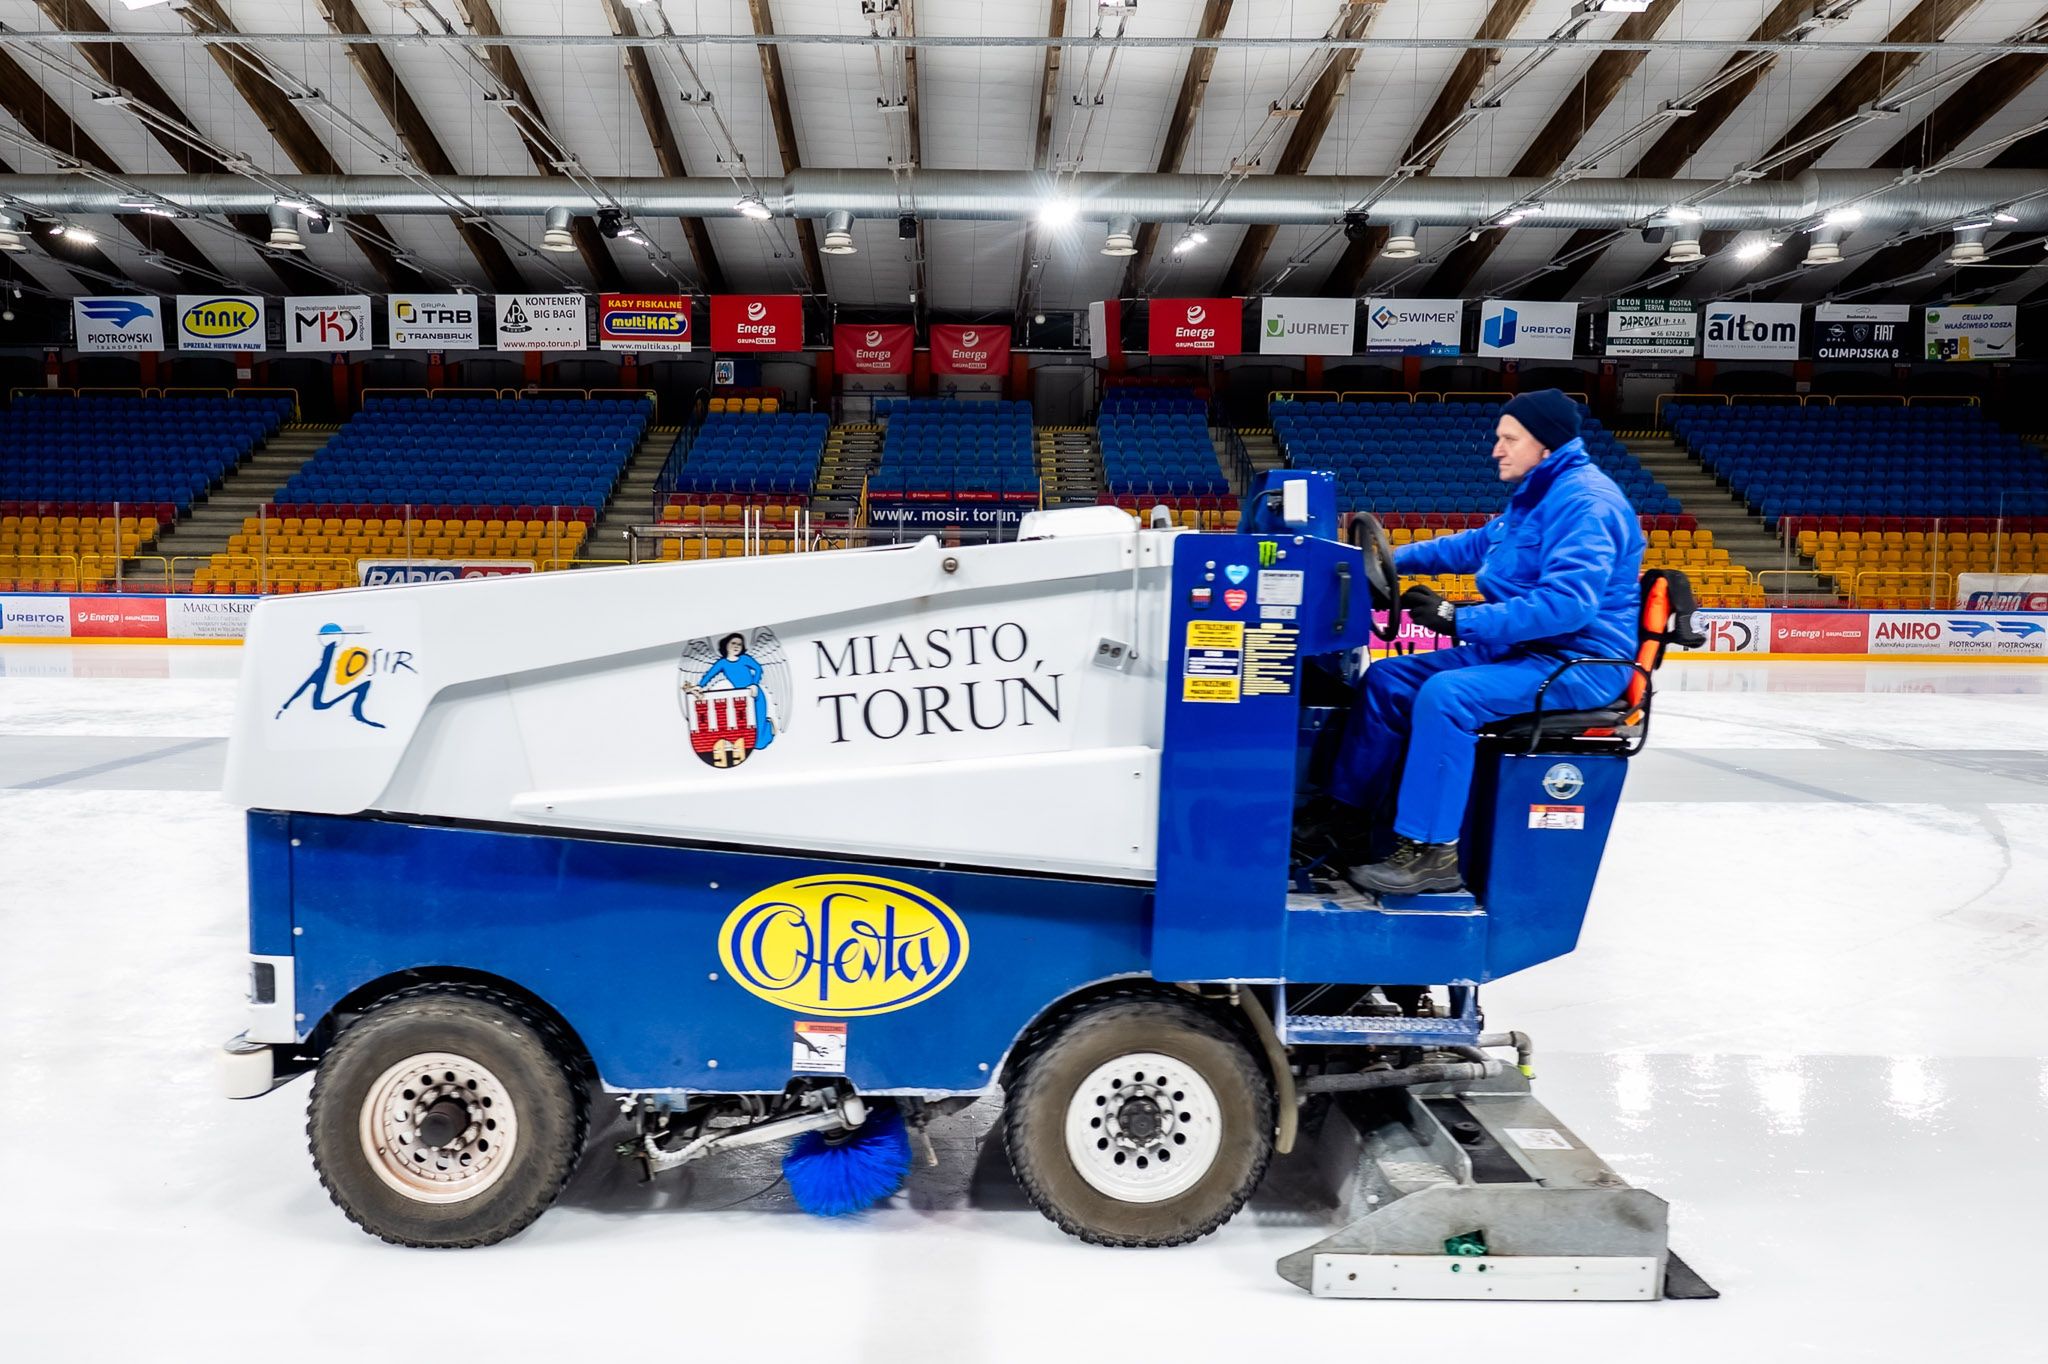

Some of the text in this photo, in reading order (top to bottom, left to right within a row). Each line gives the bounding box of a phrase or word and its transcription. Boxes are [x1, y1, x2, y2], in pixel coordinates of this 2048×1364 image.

[525, 297, 582, 306] KONTENERY
[608, 300, 683, 309] KASY FISKALNE
[1669, 299, 1692, 307] KOSTKA
[1644, 304, 1665, 312] TERIVA
[191, 309, 248, 328] TANK
[422, 310, 472, 323] TRB
[533, 309, 576, 319] BIG BAGI
[611, 315, 680, 330] multiKAS
[1619, 316, 1662, 330] PAPROCKI
[1708, 313, 1796, 342] altom
[1944, 321, 2012, 330] WŁAŚCIWEGO KOSZA
[737, 323, 776, 336] Energa
[1175, 327, 1215, 339] Energa
[1287, 323, 1349, 335] JURMET
[1521, 326, 1572, 335] URBITOR
[1874, 324, 1895, 341] FIAT
[88, 333, 153, 344] PIOTROWSKI
[503, 340, 581, 348] www.mpo.torun.pl
[611, 343, 681, 351] www.multikas.pl
[1616, 347, 1685, 355] www.paprocki.torun.pl
[856, 349, 891, 360] Energa
[952, 349, 987, 361] Energa
[1818, 347, 1899, 359] OLIMPIJSKA 8
[872, 509, 918, 521] www.
[922, 508, 969, 521] mosir.
[7, 613, 64, 623] URBITOR
[90, 613, 120, 623] Energa
[1790, 629, 1821, 640] Energa
[1875, 622, 1941, 640] ANIRO
[813, 622, 1027, 680] MIASTO
[817, 659, 1064, 744] TORUŃ
